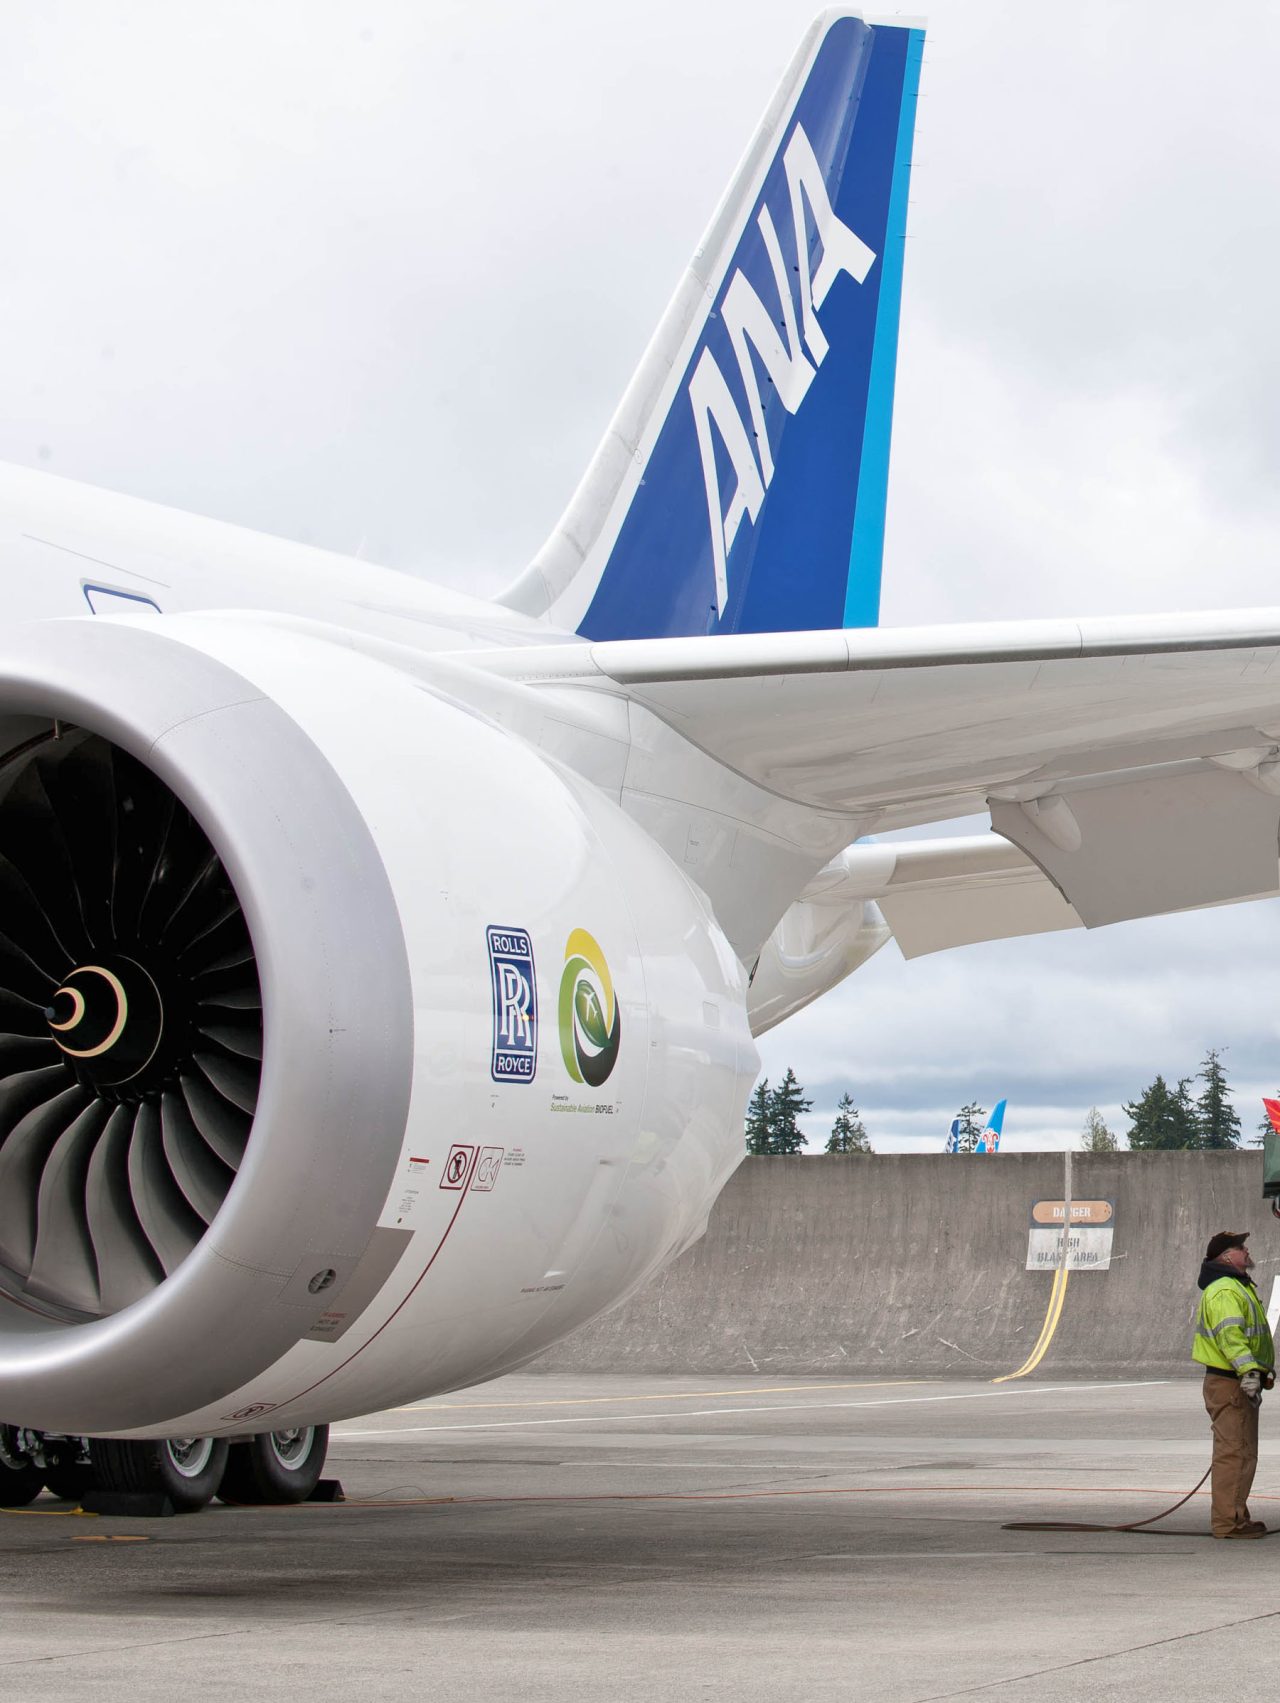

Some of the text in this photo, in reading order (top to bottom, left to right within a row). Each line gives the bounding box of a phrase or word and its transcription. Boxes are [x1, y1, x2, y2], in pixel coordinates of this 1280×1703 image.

[688, 121, 877, 620] ANA
[493, 936, 528, 954] ROLLS
[497, 1056, 531, 1073] ROYCE
[595, 1104, 614, 1114] BIOFUEL
[1057, 1237, 1080, 1248] HGH
[1073, 1251, 1098, 1262] AREA
